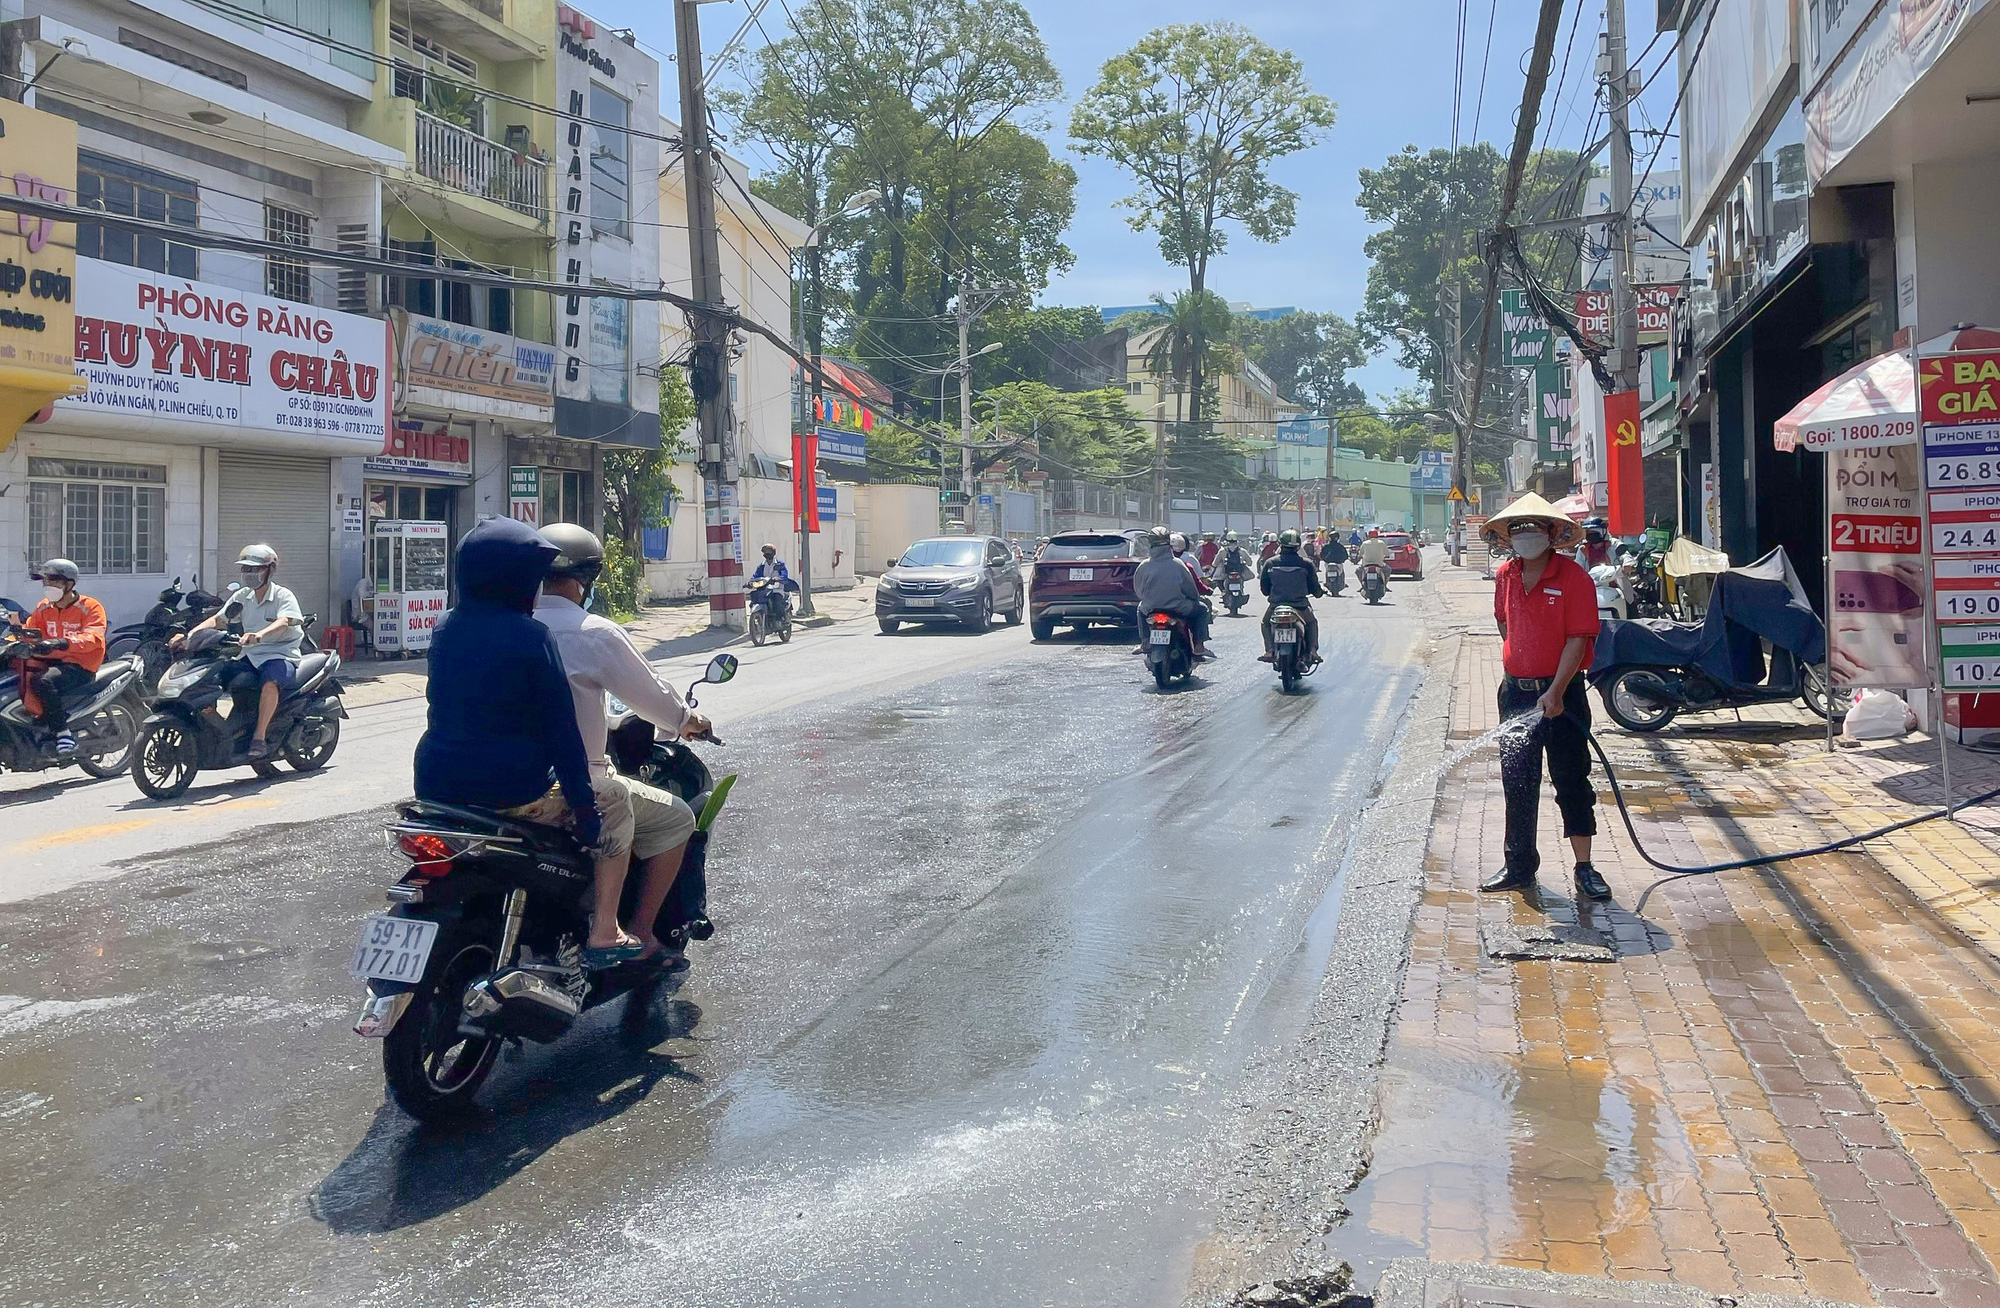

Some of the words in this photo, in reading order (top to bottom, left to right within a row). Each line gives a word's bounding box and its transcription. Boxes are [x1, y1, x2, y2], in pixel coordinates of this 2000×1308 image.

[560, 32, 588, 62] Photo
[588, 48, 616, 79] Studio
[1600, 191, 1647, 207] NA
[138, 282, 249, 328] PHÒNG
[257, 304, 334, 344] RĂNG
[75, 316, 252, 387] HUỲNH
[270, 349, 379, 403] CHÂU
[410, 336, 517, 387] Chiến
[90, 368, 125, 387] HUỲNH
[127, 375, 147, 391] DUY
[147, 376, 179, 394] THÔNG
[90, 389, 104, 404] VÕ
[106, 391, 127, 408] VĂN
[159, 399, 186, 415] P.LINH
[216, 407, 225, 420] Q.
[226, 407, 238, 420] TĐ
[288, 397, 299, 409] GP
[300, 396, 312, 411] SỐ:
[1938, 384, 1998, 415] GIÁ
[276, 413, 289, 426] ĐT:
[290, 416, 302, 427] 028
[304, 417, 313, 428] 38
[314, 418, 326, 430] 963
[328, 420, 340, 431] 596
[344, 422, 361, 434] 0778
[362, 423, 384, 436] 727225
[1806, 428, 1836, 446] Gọi:
[1935, 430, 1982, 442] IPHONE
[1986, 430, 2000, 440] 13
[409, 460, 429, 468] TRANG
[512, 502, 536, 523] IN
[1846, 496, 1870, 510] TRỢ
[1871, 496, 1890, 508] GIÁ
[1835, 520, 1855, 546] 2
[1856, 522, 1918, 550] TRIỆU
[379, 599, 398, 607] THAY
[408, 600, 424, 612] MUA
[378, 636, 398, 644] SAPHIA
[537, 862, 557, 874] AIR
[370, 919, 424, 950] 59-X1
[356, 947, 421, 978] 177.01
